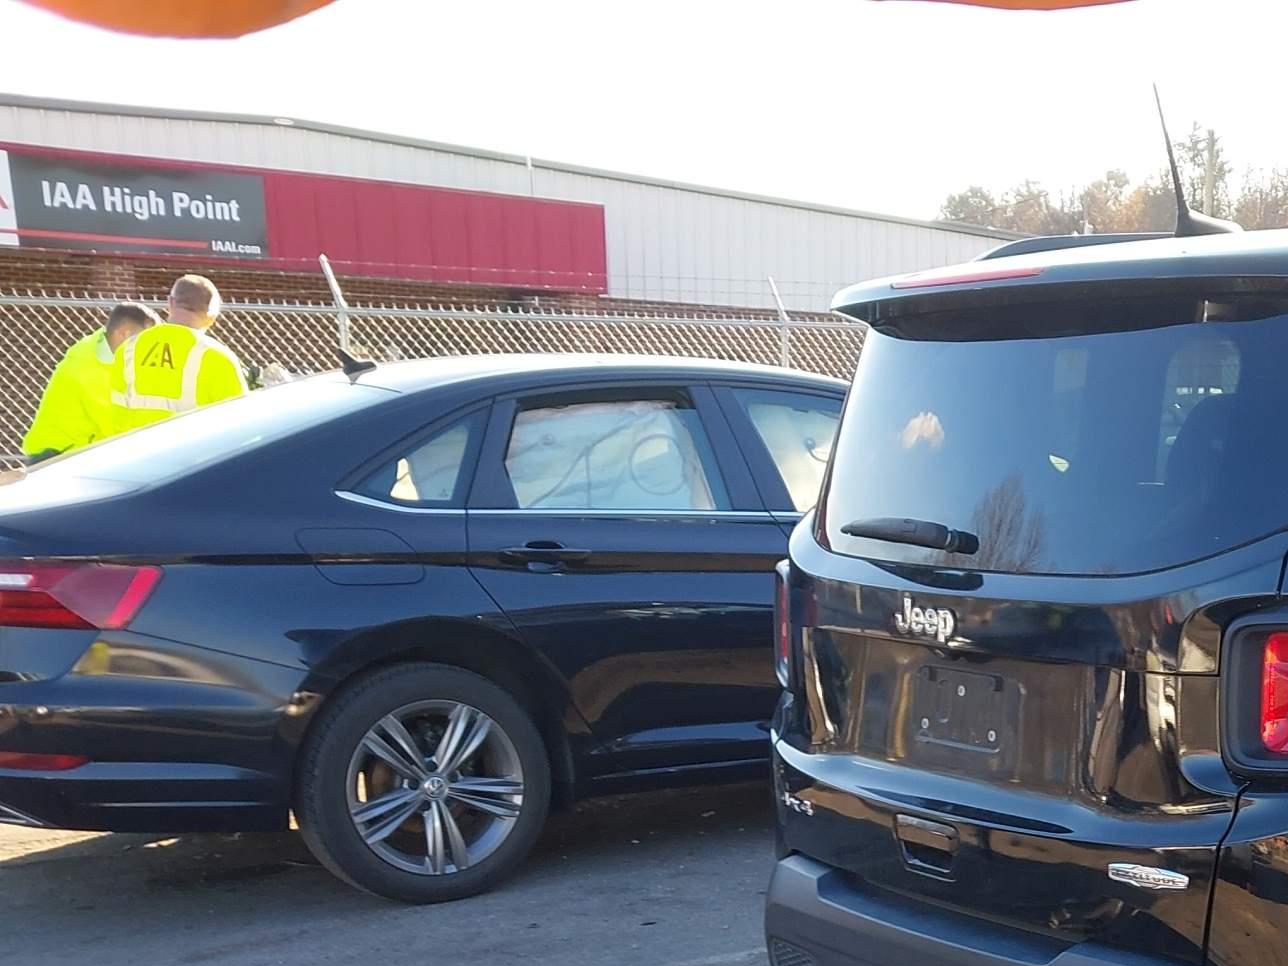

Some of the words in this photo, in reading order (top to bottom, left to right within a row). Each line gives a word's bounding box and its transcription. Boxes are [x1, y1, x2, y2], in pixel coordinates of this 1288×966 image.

[41, 180, 97, 211] IAA
[102, 186, 166, 221] High
[171, 191, 241, 222] Point
[211, 240, 261, 254] IAAI.com
[894, 596, 954, 643] Jeep
